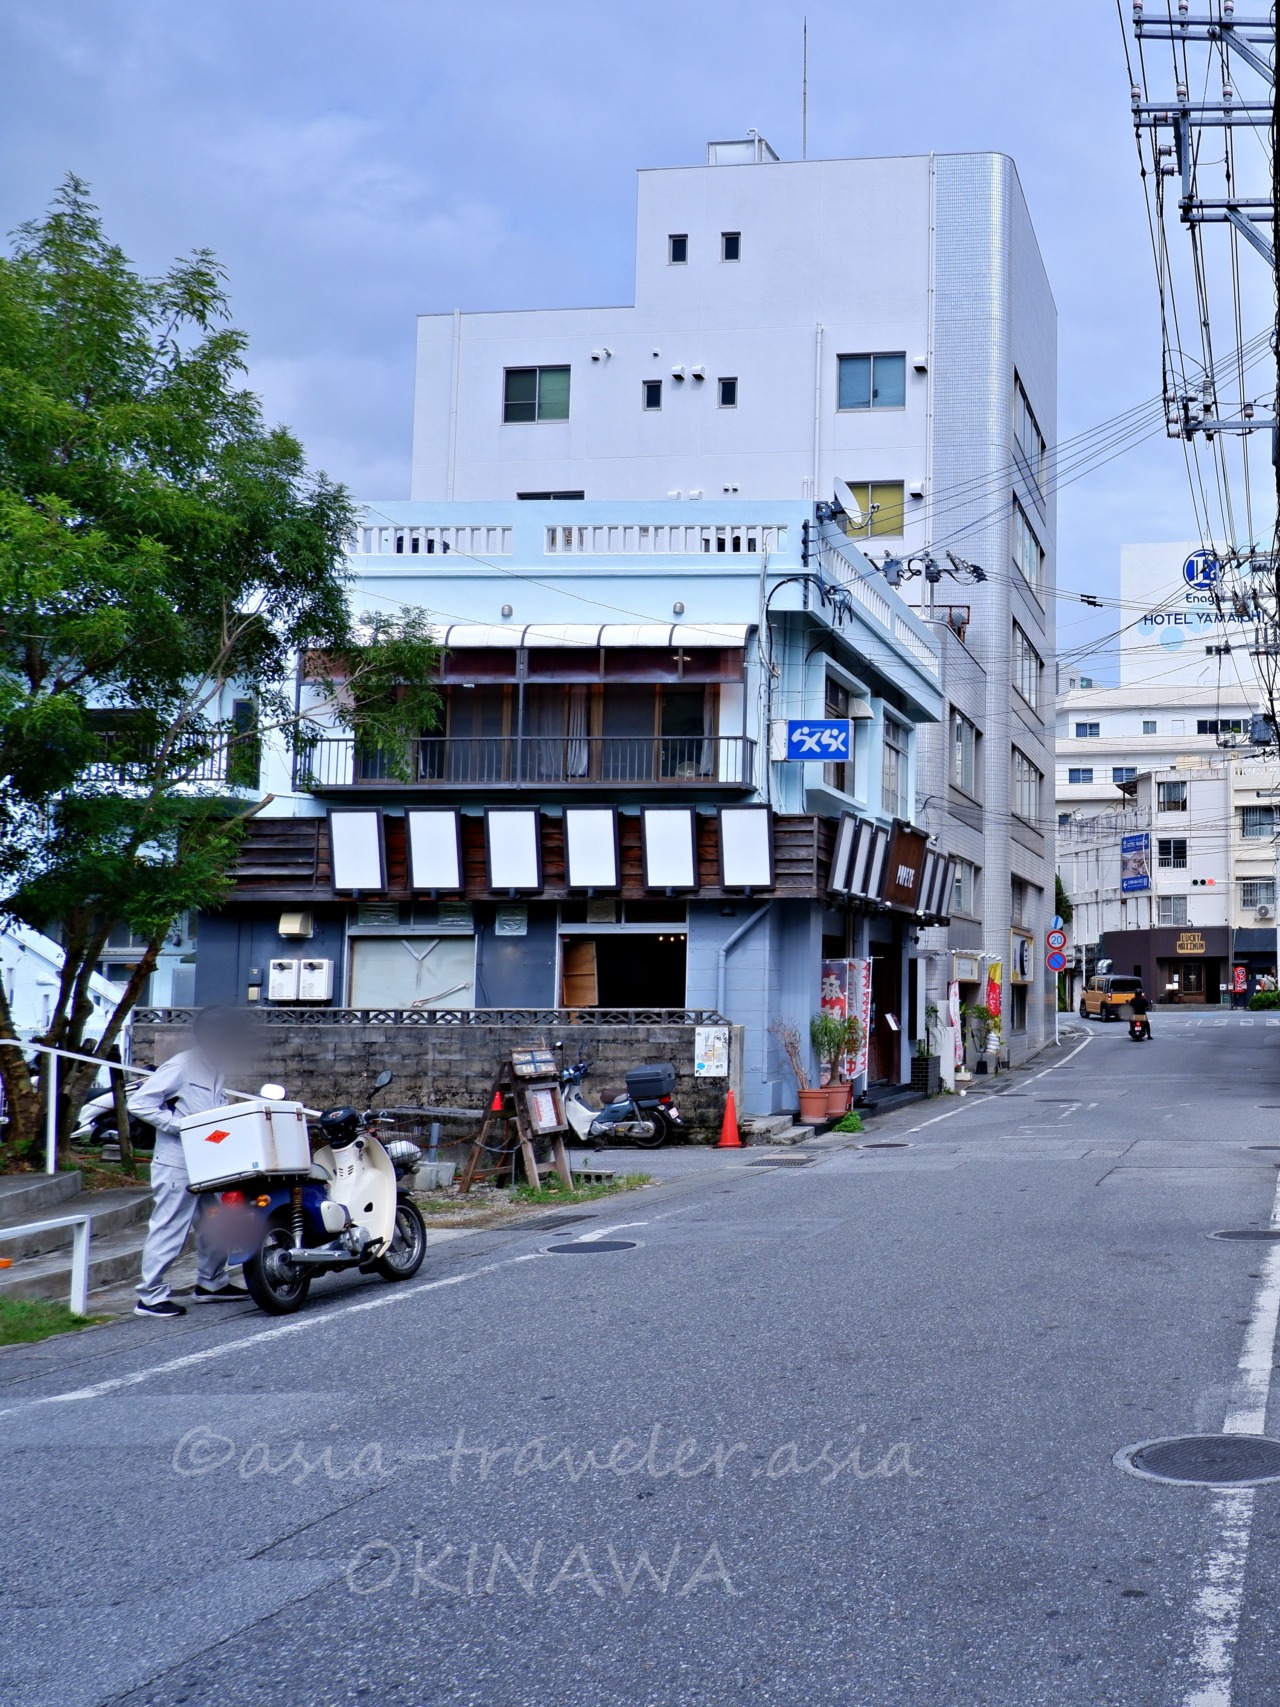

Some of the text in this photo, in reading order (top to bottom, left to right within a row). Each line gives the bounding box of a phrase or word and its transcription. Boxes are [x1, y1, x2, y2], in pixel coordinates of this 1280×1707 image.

[1185, 593, 1219, 605] Enag
[1144, 613, 1193, 626] HOTEL
[1051, 936, 1062, 945] 20
[1181, 933, 1201, 942] LUCKY
